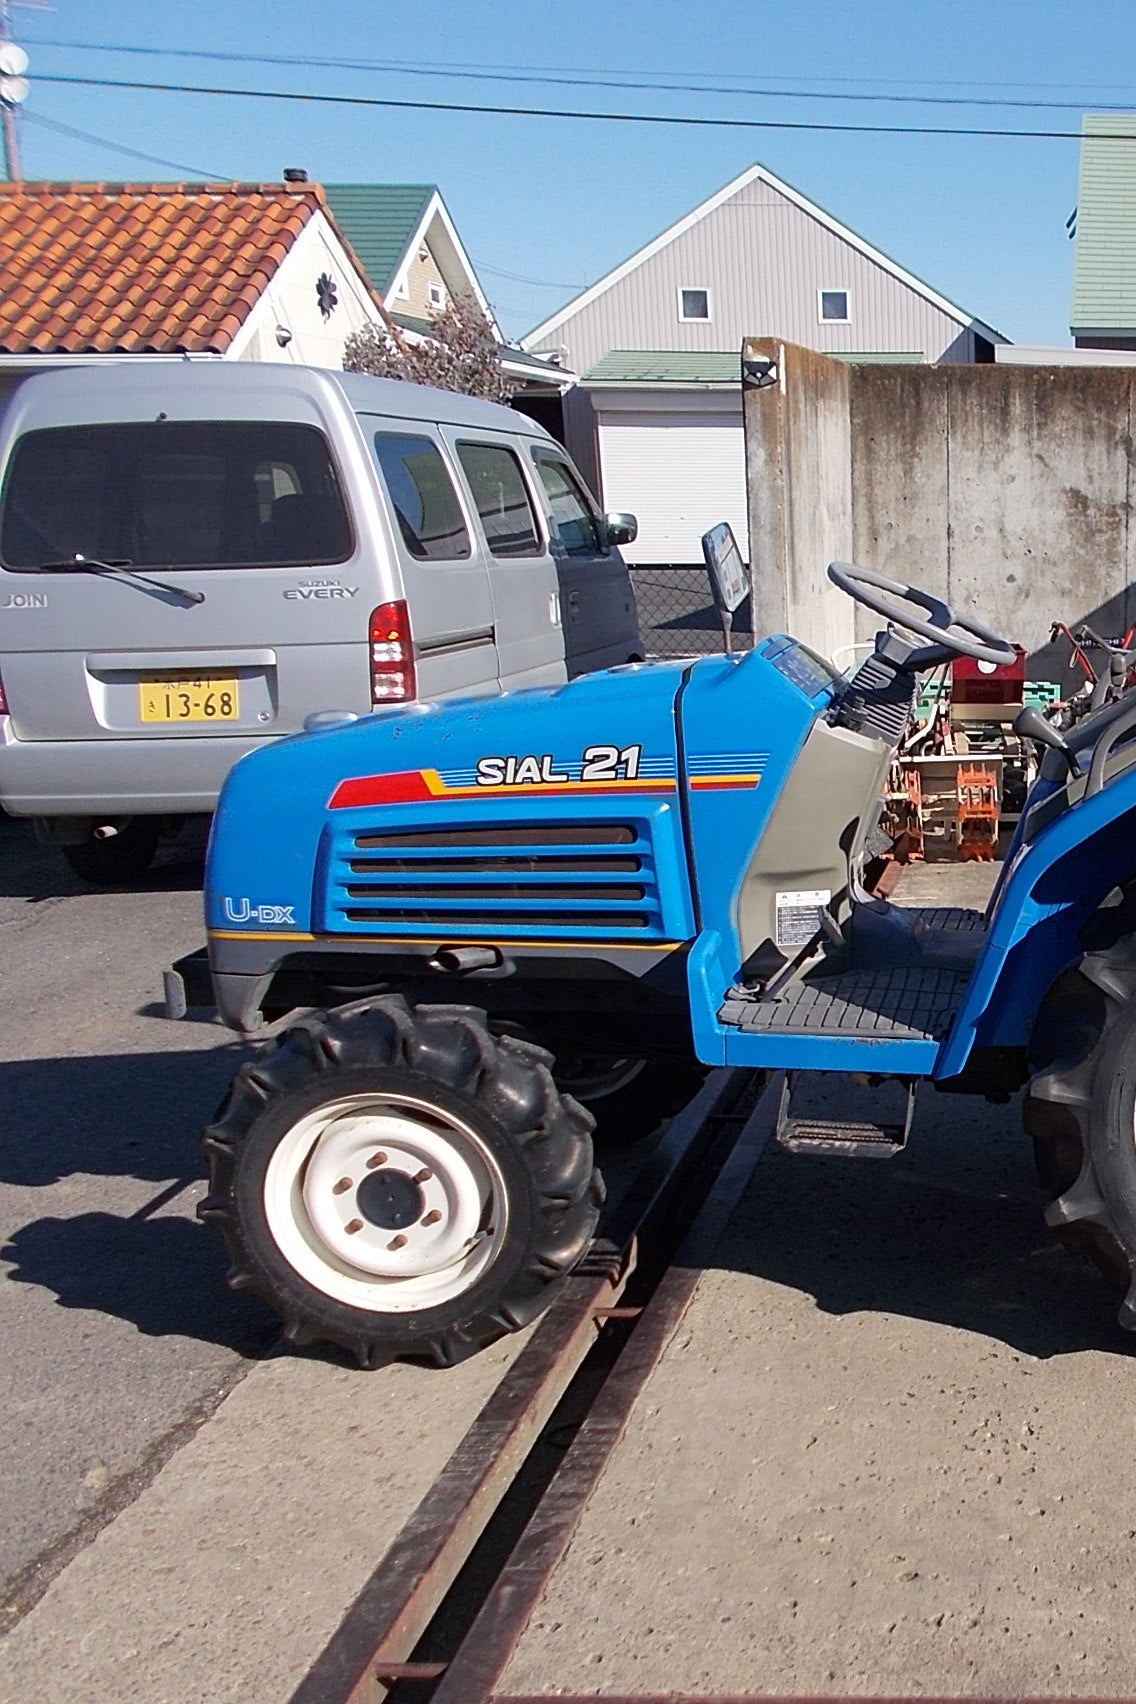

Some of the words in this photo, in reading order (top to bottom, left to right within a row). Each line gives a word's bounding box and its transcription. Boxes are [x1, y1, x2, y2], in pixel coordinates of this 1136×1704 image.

[2, 594, 48, 608] JOIN
[282, 587, 360, 600] EVERY
[165, 692, 233, 718] 13-68
[476, 754, 569, 786] SIAL
[580, 744, 643, 782] 21
[225, 897, 296, 924] U-DX
